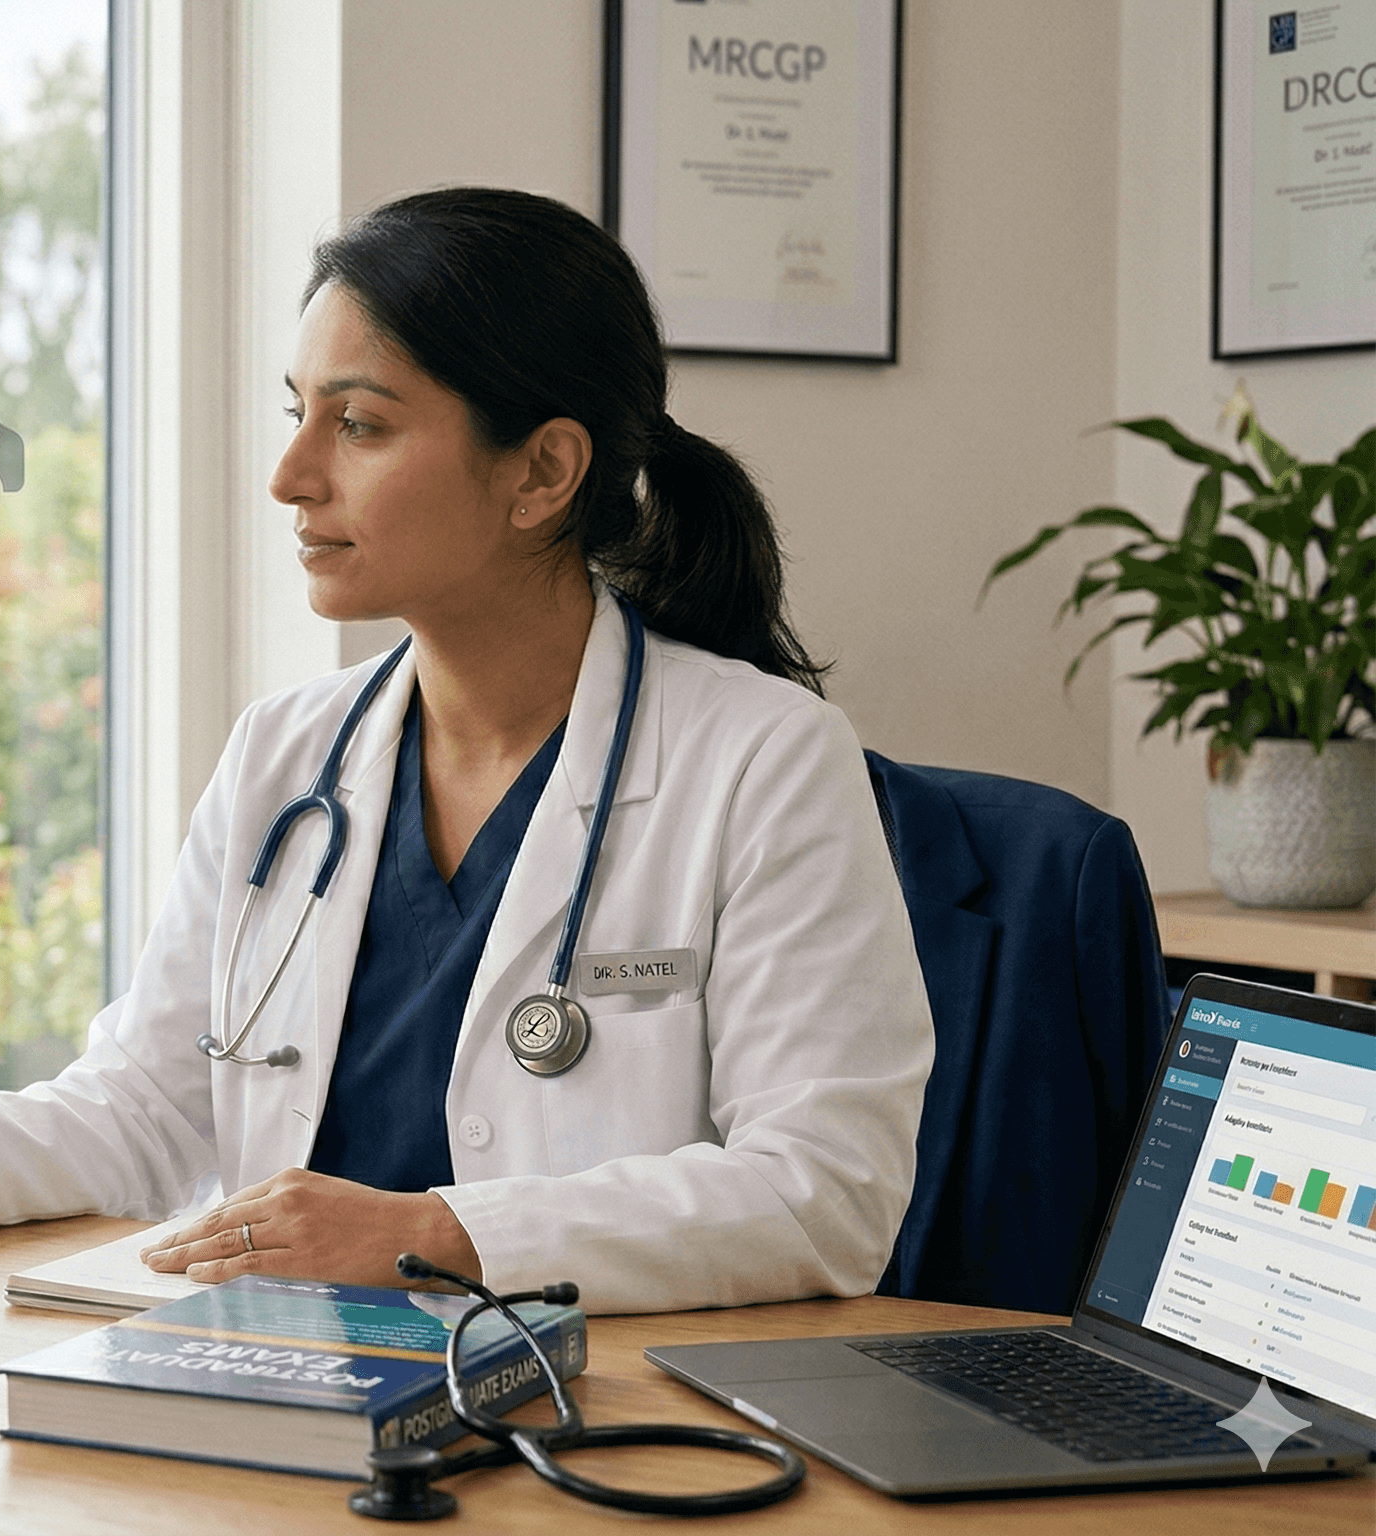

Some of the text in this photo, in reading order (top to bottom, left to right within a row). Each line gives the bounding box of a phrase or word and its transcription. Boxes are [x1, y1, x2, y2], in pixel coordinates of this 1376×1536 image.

[688, 34, 827, 82] MRCGP
[619, 964, 632, 978] S.
[635, 962, 678, 977] NATEL
[176, 1341, 355, 1371] EXAMS
[501, 1355, 540, 1395] EXAMS
